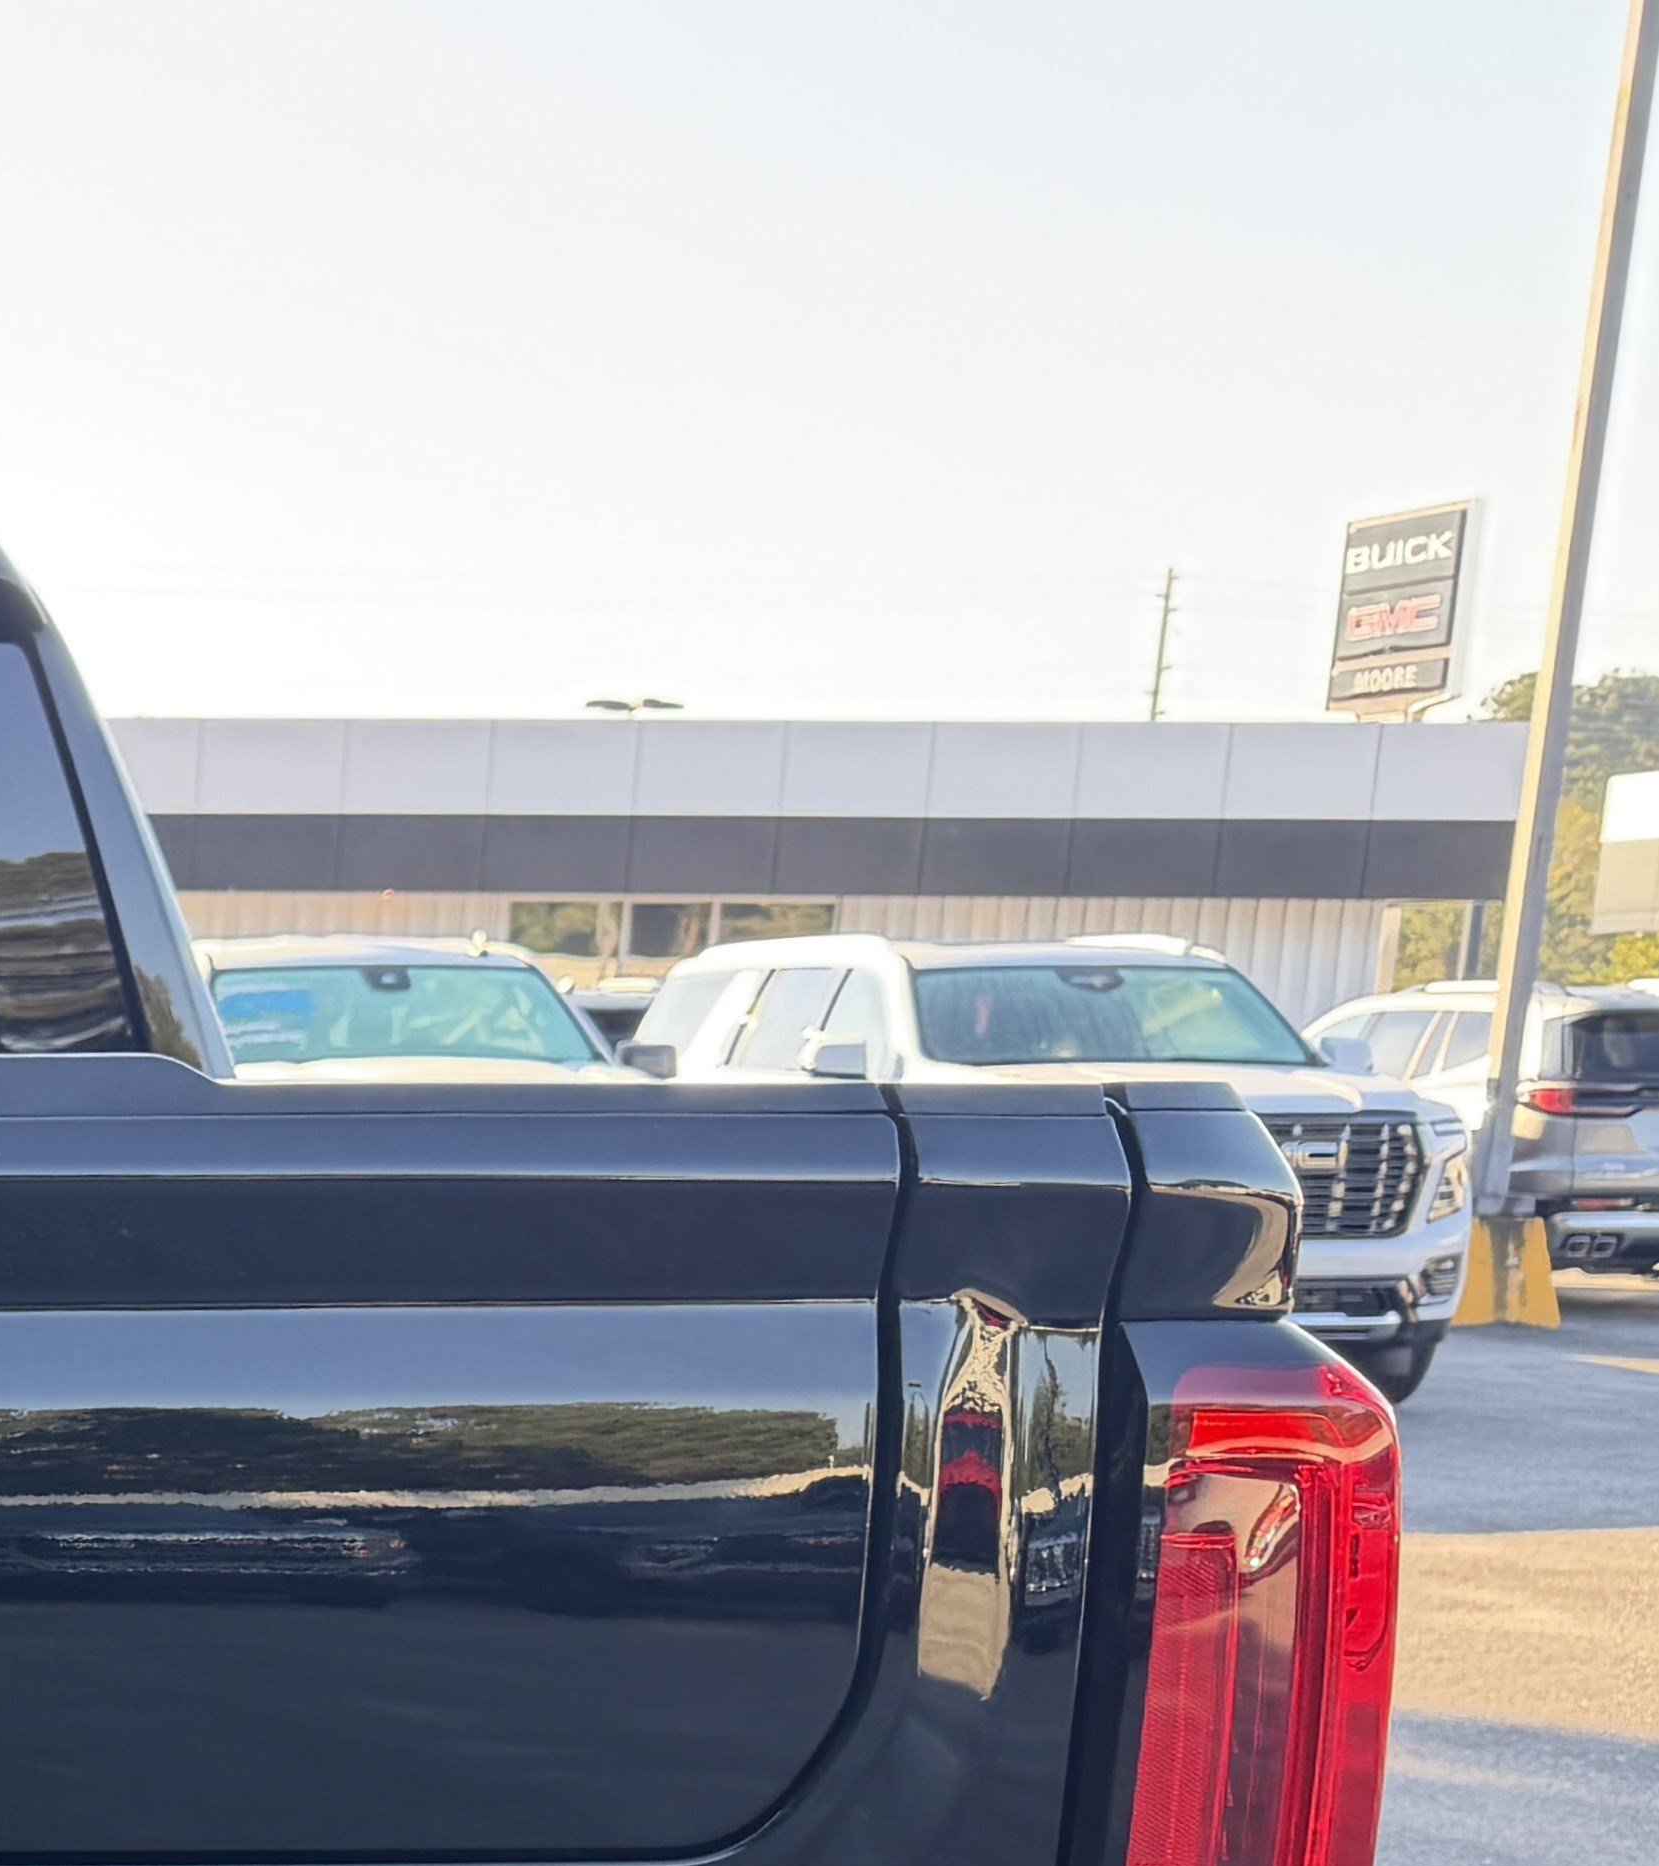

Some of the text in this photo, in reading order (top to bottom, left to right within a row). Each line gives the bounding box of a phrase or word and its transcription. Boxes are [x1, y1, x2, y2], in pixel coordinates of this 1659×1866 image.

[1345, 531, 1455, 575] BUICK
[1346, 595, 1441, 642] GMC
[1353, 665, 1418, 694] MOORE
